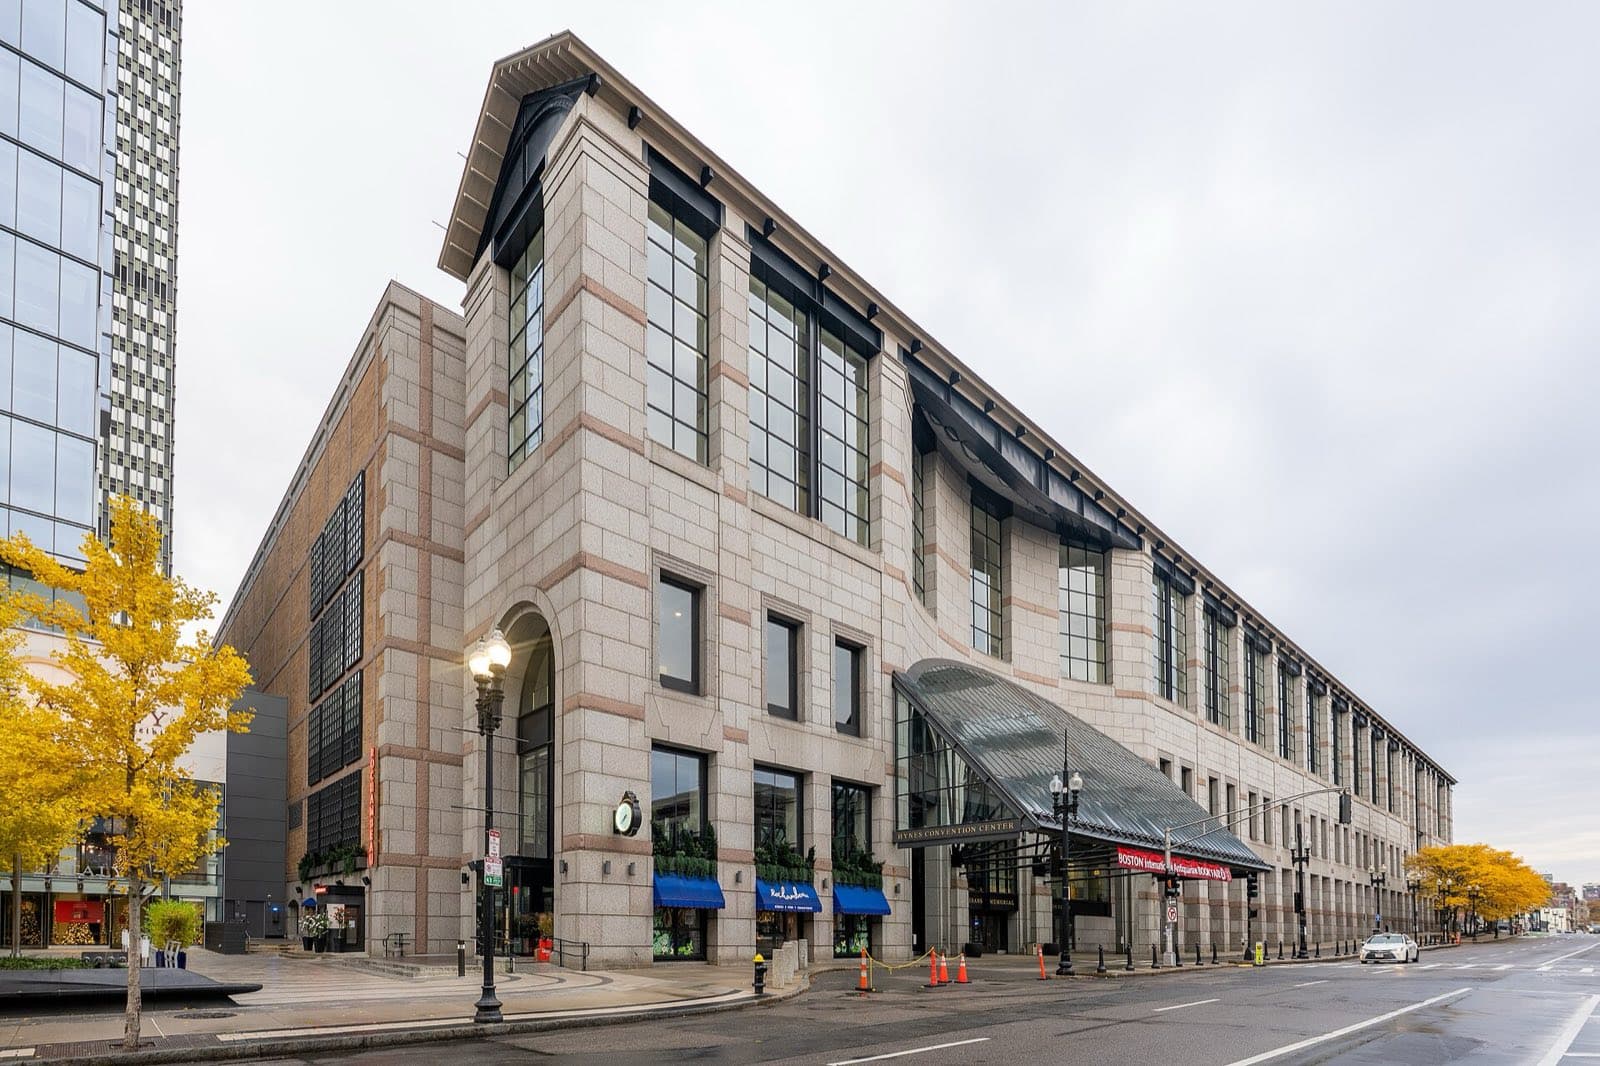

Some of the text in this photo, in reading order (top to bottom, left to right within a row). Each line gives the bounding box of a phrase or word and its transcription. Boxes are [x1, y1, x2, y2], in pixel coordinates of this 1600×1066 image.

[898, 822, 1014, 840] HYNES CONVENTION CENTER
[1118, 853, 1143, 868] BOSTON
